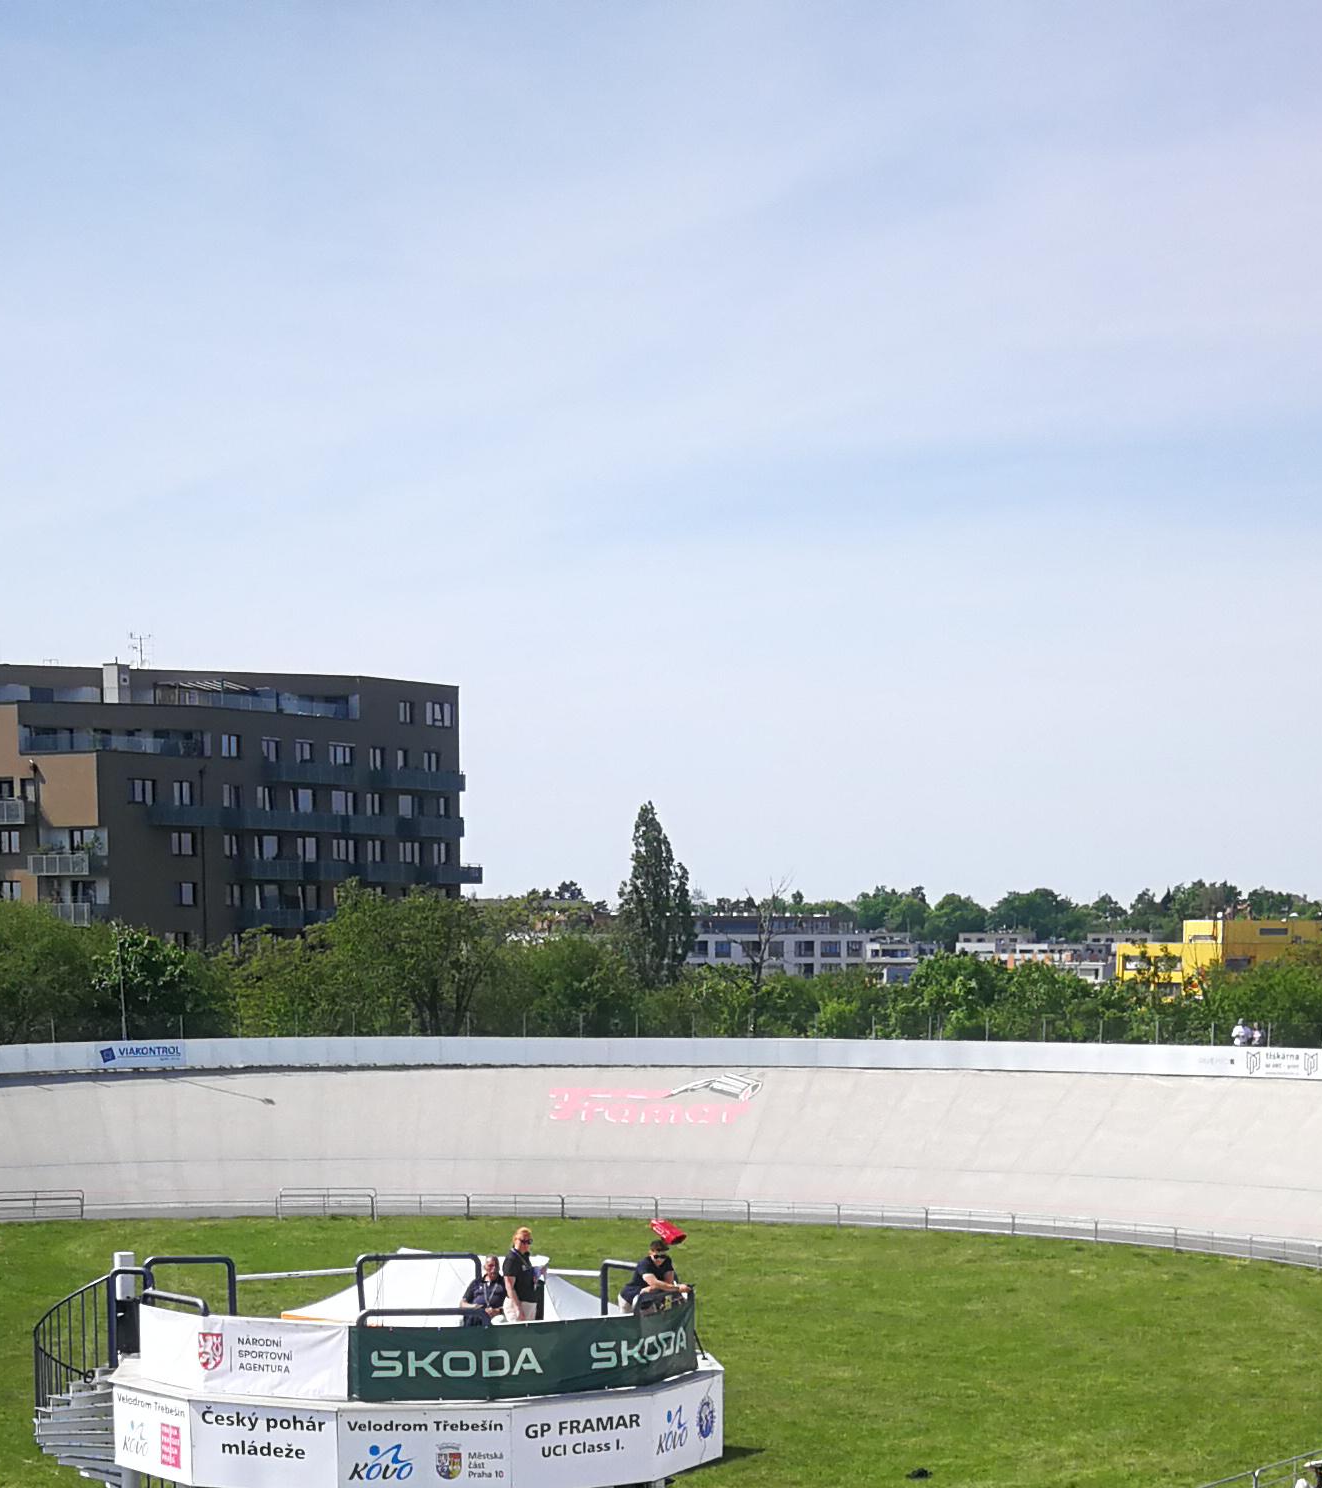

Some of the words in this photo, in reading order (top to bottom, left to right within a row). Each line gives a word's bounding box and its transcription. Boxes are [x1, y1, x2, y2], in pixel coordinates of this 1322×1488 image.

[118, 1046, 181, 1056] VIAKONTROL
[237, 1335, 282, 1347] NÁRODNÍ
[238, 1349, 293, 1361] SPORTOVNÍ
[239, 1362, 290, 1374] AGENTURA
[201, 1405, 259, 1432] Český
[266, 1413, 326, 1432] pohár
[347, 1420, 428, 1432] Velodrom
[433, 1420, 504, 1432] Třebešín
[525, 1423, 552, 1439] GP
[558, 1413, 641, 1436] FRAMAR
[221, 1440, 306, 1460] mládeže
[467, 1451, 504, 1460] Městská
[541, 1444, 567, 1458] UCI
[572, 1442, 611, 1455] Class
[467, 1461, 485, 1469] část
[348, 1462, 413, 1481] KOVO
[467, 1470, 493, 1479] Praha
[494, 1470, 504, 1479] 10
